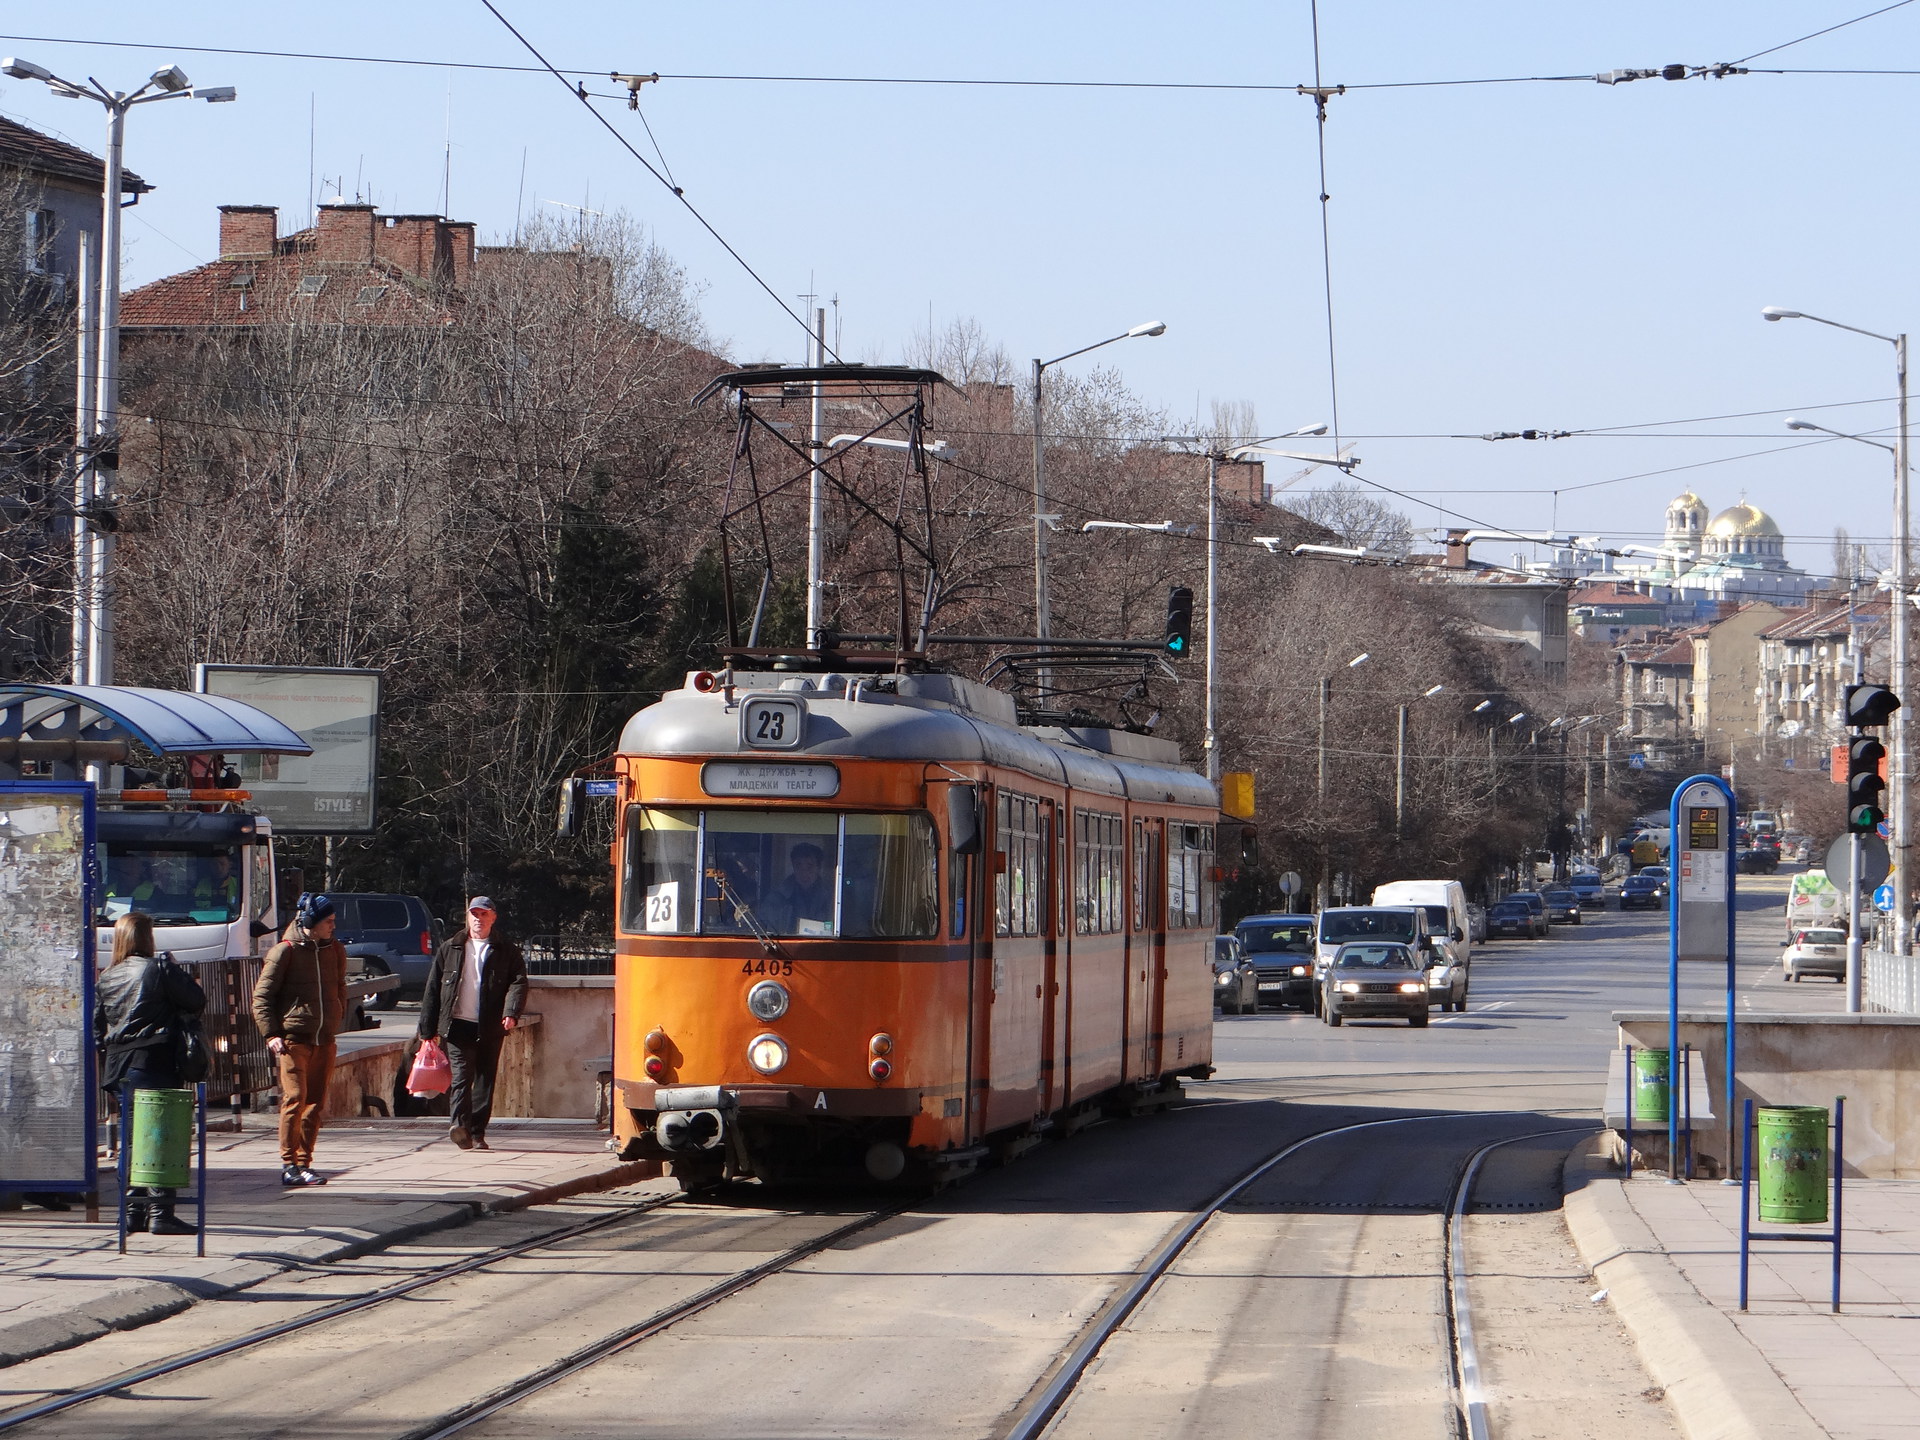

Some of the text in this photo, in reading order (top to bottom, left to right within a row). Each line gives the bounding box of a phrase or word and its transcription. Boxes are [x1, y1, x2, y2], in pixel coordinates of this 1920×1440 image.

[757, 710, 784, 740] 23
[759, 767, 797, 778] ДРУЖБА
[808, 767, 813, 777] 2
[729, 780, 817, 791] МЛАДЕЖКИ ТЕАТЪР
[313, 797, 352, 812] iSTYLE
[651, 895, 672, 923] 23
[741, 959, 793, 977] 4405
